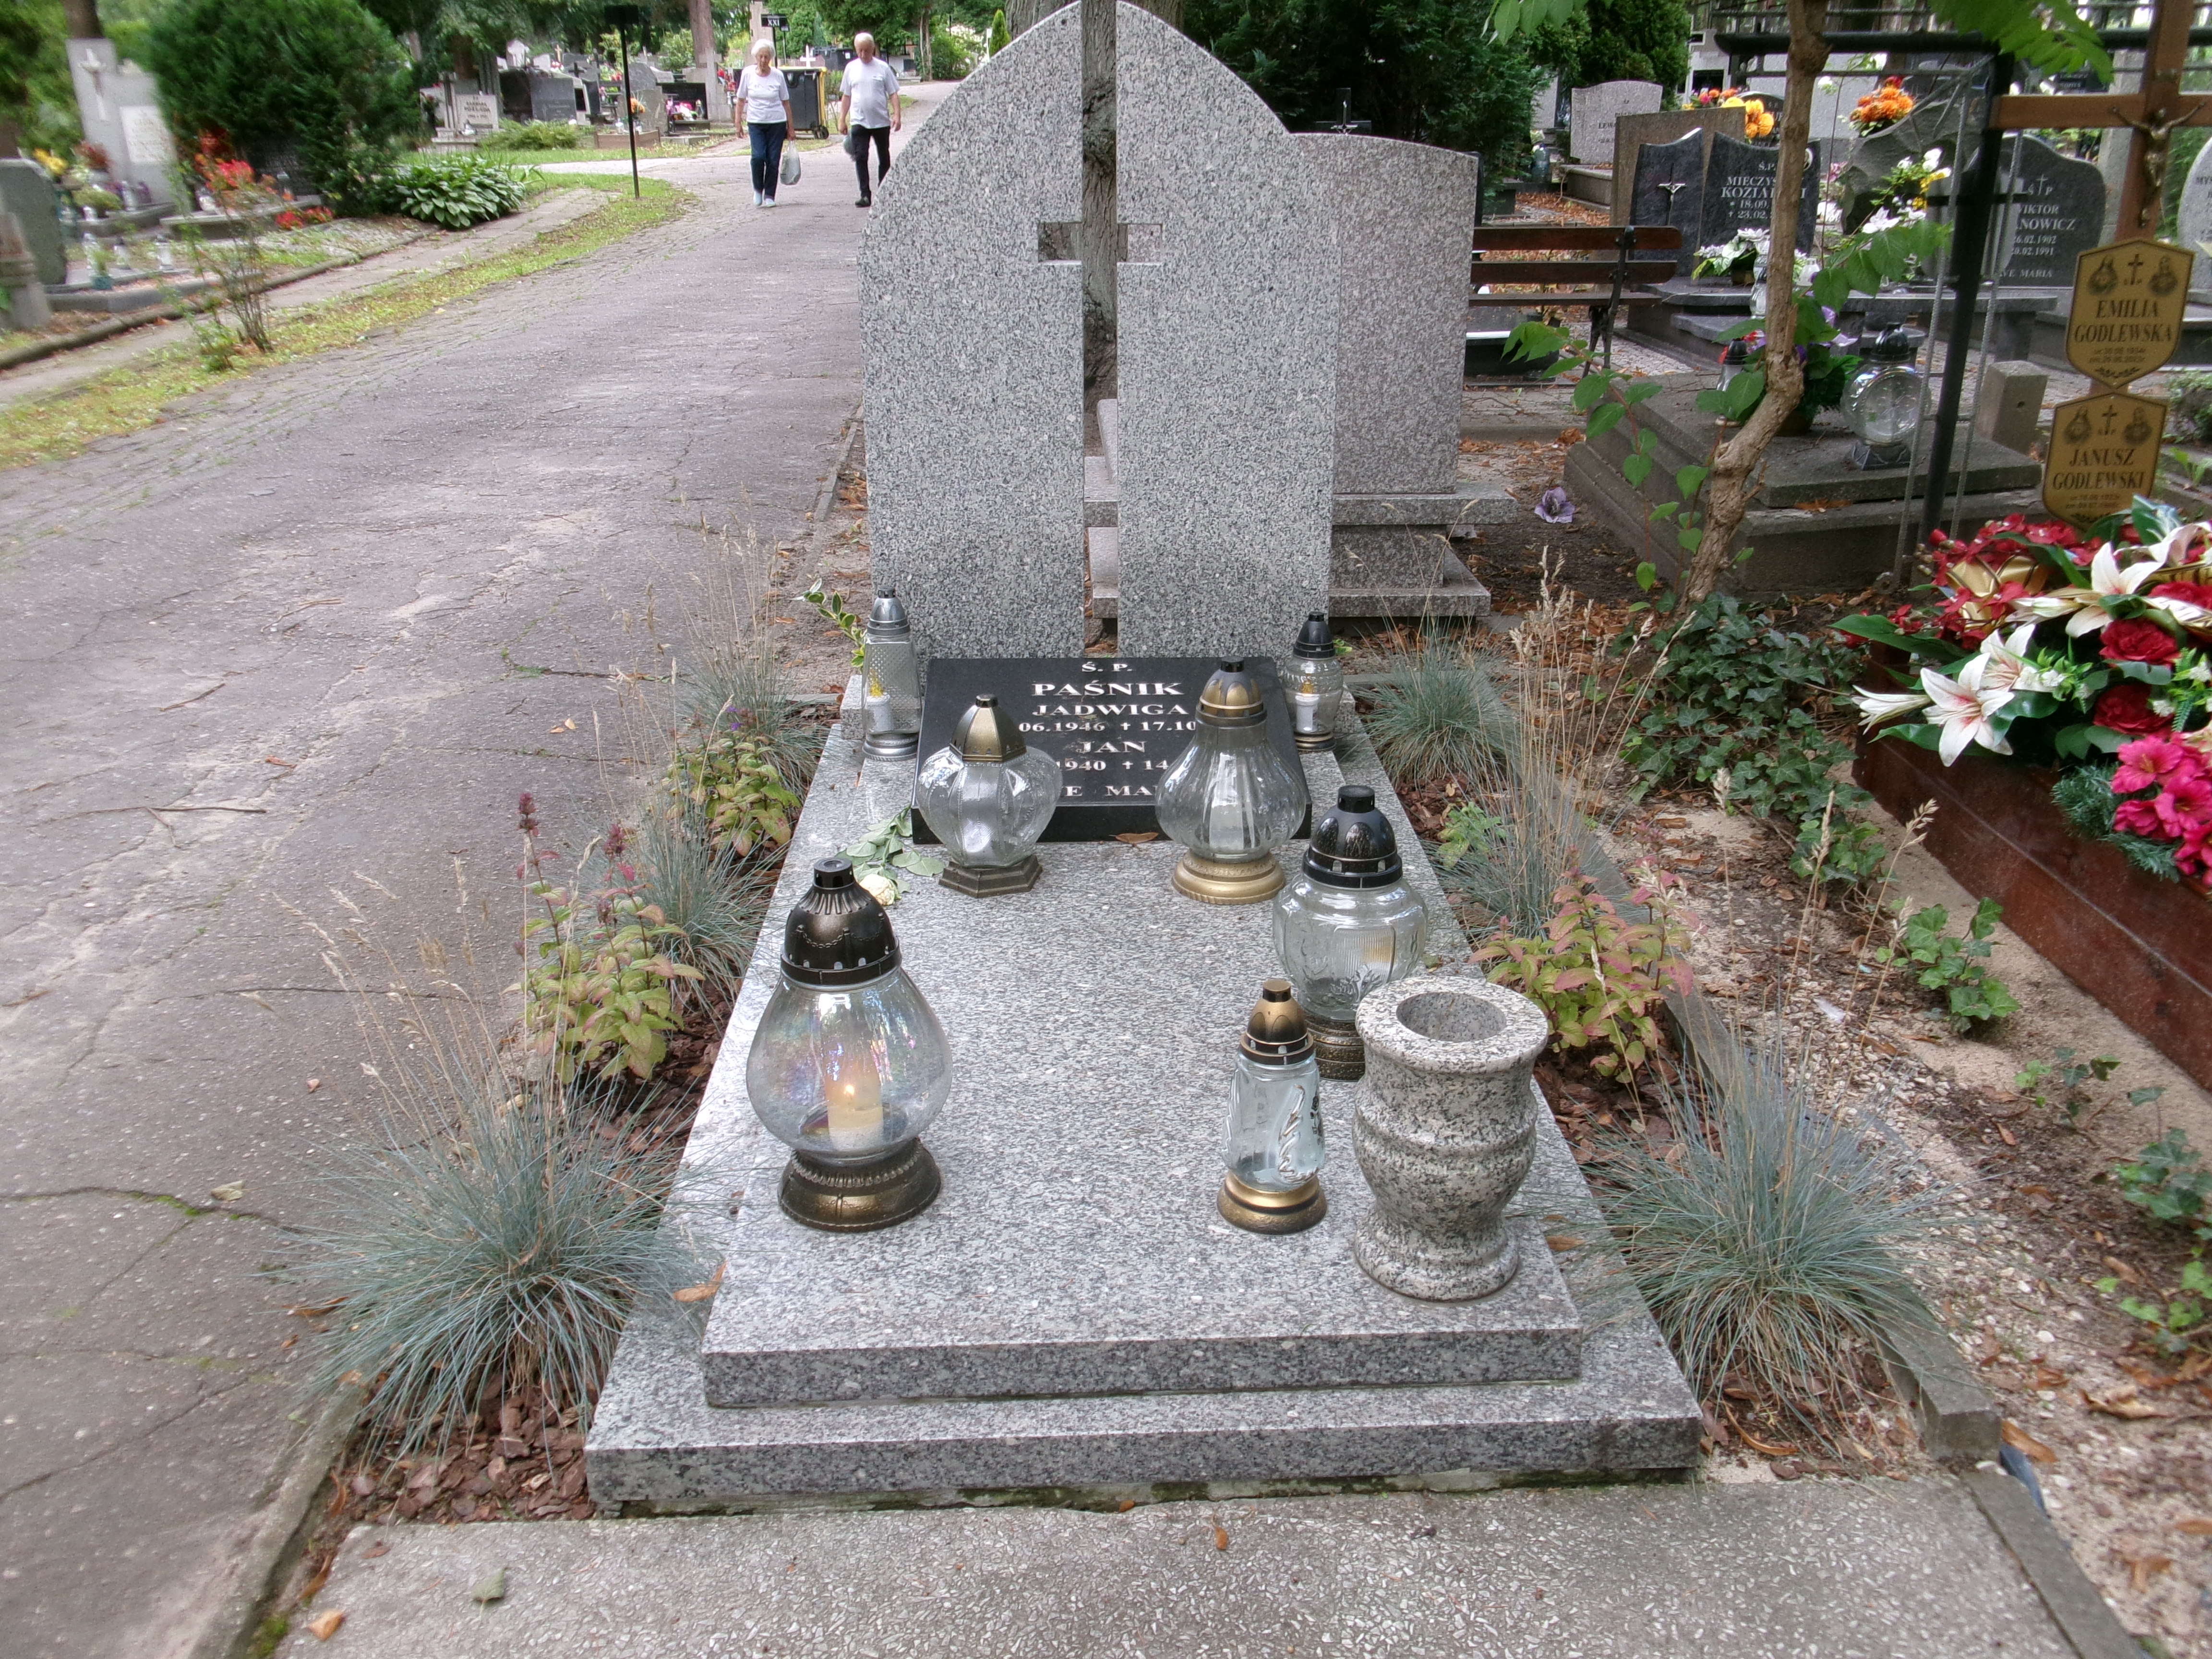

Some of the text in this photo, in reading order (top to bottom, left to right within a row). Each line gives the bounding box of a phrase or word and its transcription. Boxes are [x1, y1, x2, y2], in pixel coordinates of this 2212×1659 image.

[2021, 204, 2059, 214] IKTOR
[2017, 218, 2077, 230] NOWICZ
[2020, 269, 2052, 277] MARIA
[2096, 299, 2159, 318] EMILIA
[2074, 324, 2172, 343] GODLEWSKA
[2069, 448, 2136, 467] JANUSZ
[2052, 471, 2146, 490] GODLEWSKI
[1112, 663, 1132, 672] P.
[1031, 680, 1185, 696] PAŚNIK
[1032, 704, 1189, 716] JADWIGA
[1018, 721, 1196, 732] 06.1946 17.10
[1076, 741, 1147, 754] JAN
[1143, 760, 1169, 771] 14
